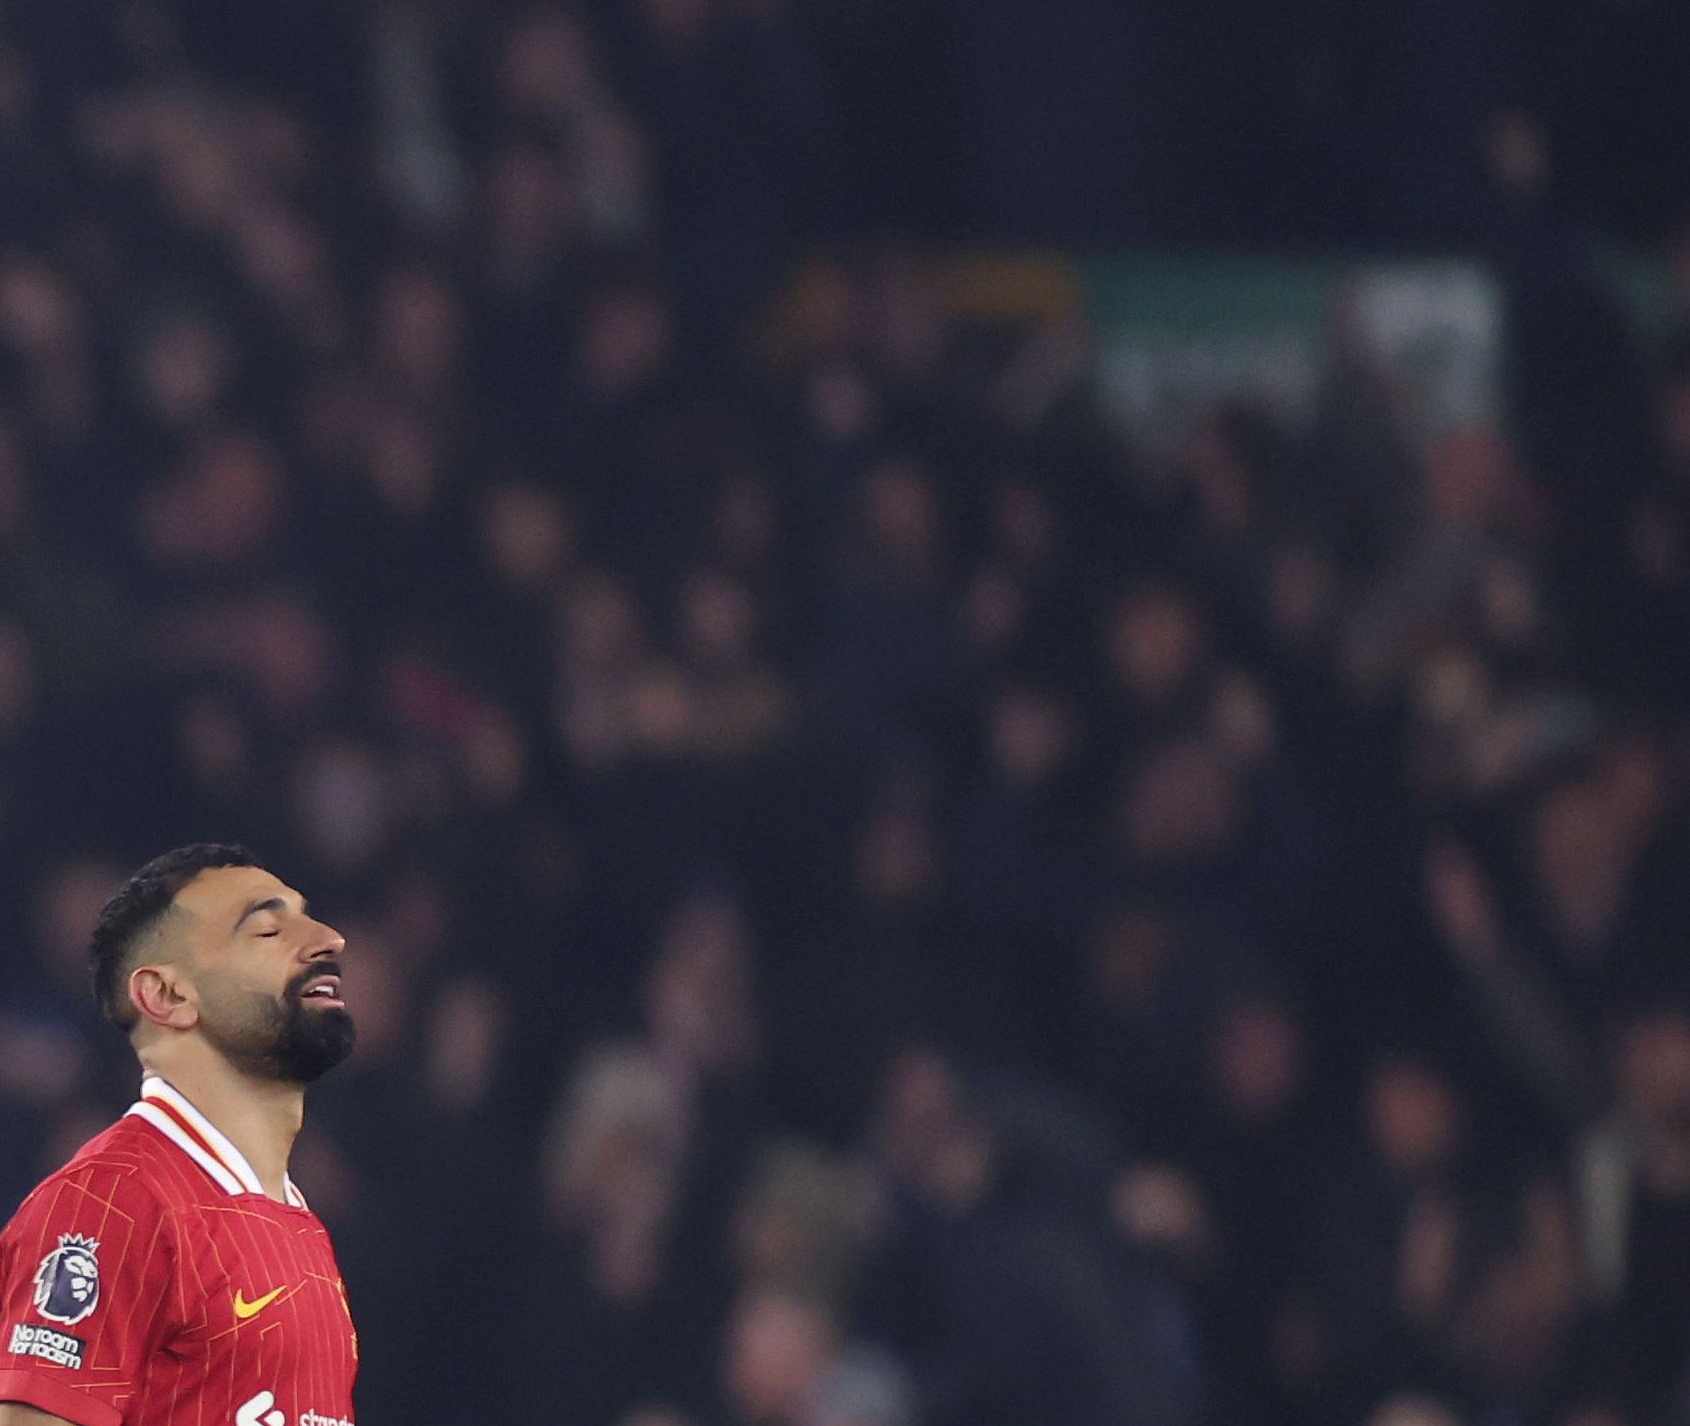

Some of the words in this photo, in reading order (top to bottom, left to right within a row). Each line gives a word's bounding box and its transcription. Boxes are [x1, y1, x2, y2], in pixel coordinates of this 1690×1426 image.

[7, 1338, 32, 1355] for
[10, 1323, 35, 1342] No
[34, 1328, 79, 1354] room
